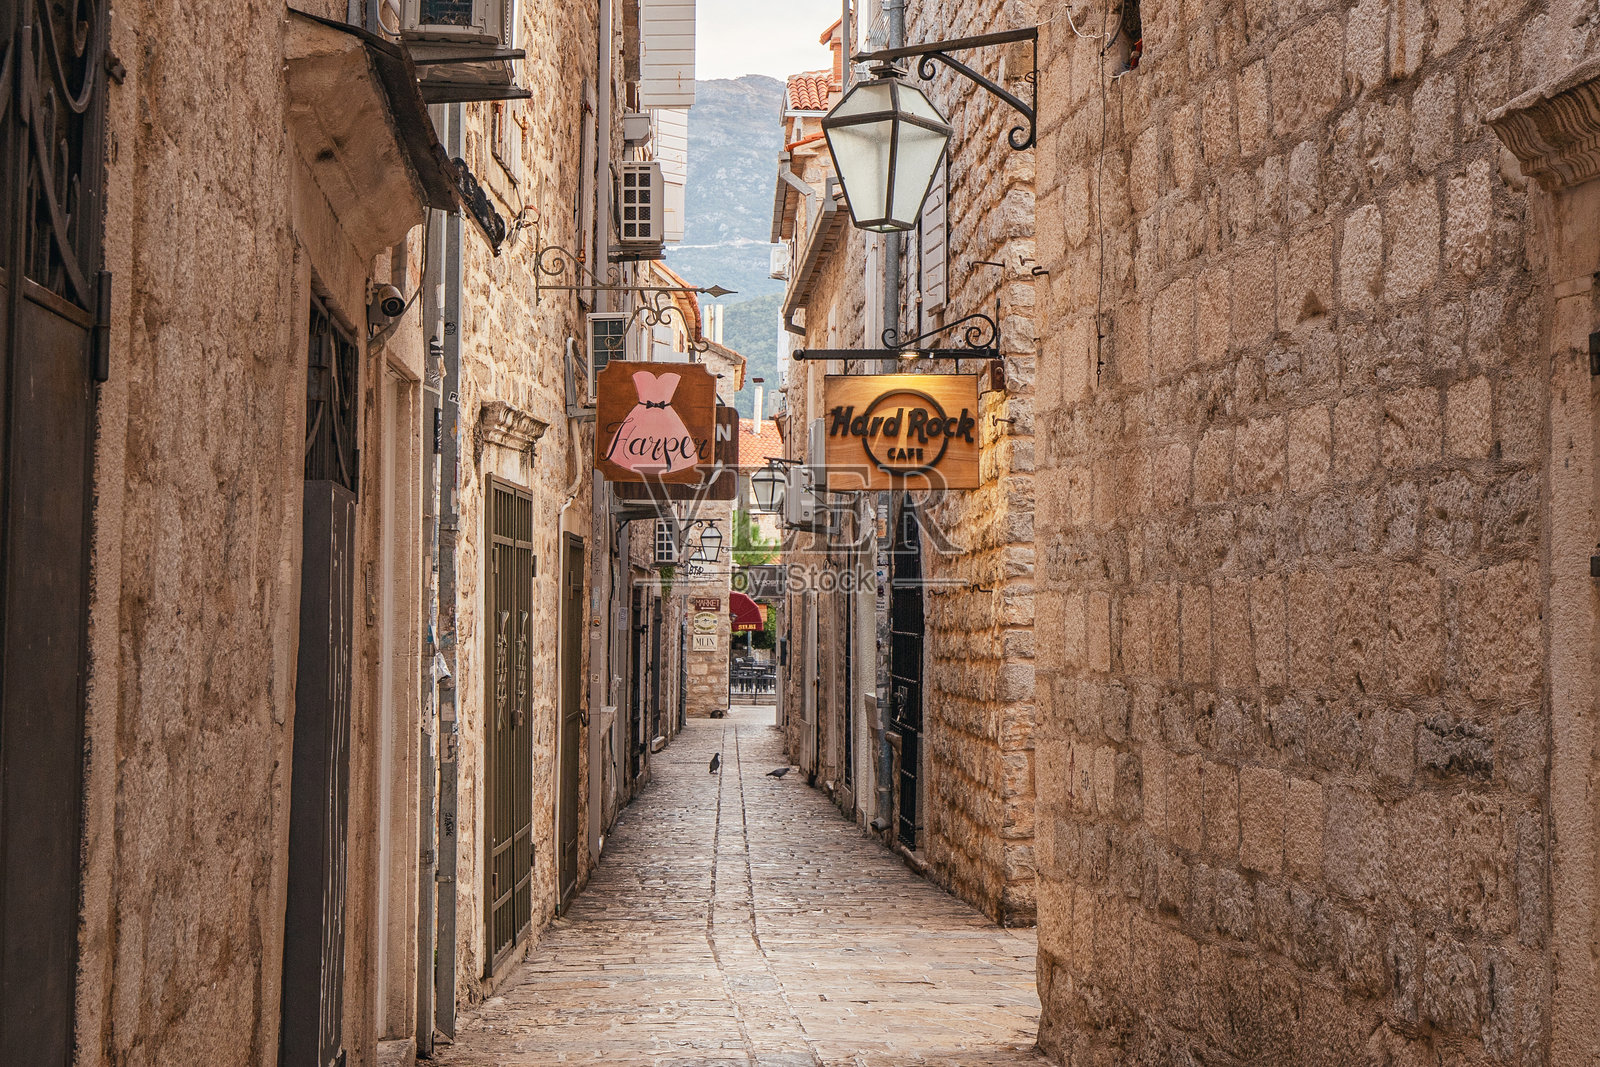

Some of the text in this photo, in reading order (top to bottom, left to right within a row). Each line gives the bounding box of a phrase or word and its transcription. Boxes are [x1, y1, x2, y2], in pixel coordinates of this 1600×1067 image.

[830, 405, 975, 444] Hard Rock
[600, 417, 710, 472] Harper
[887, 447, 924, 460] CAFE
[695, 599, 719, 607] MARKET
